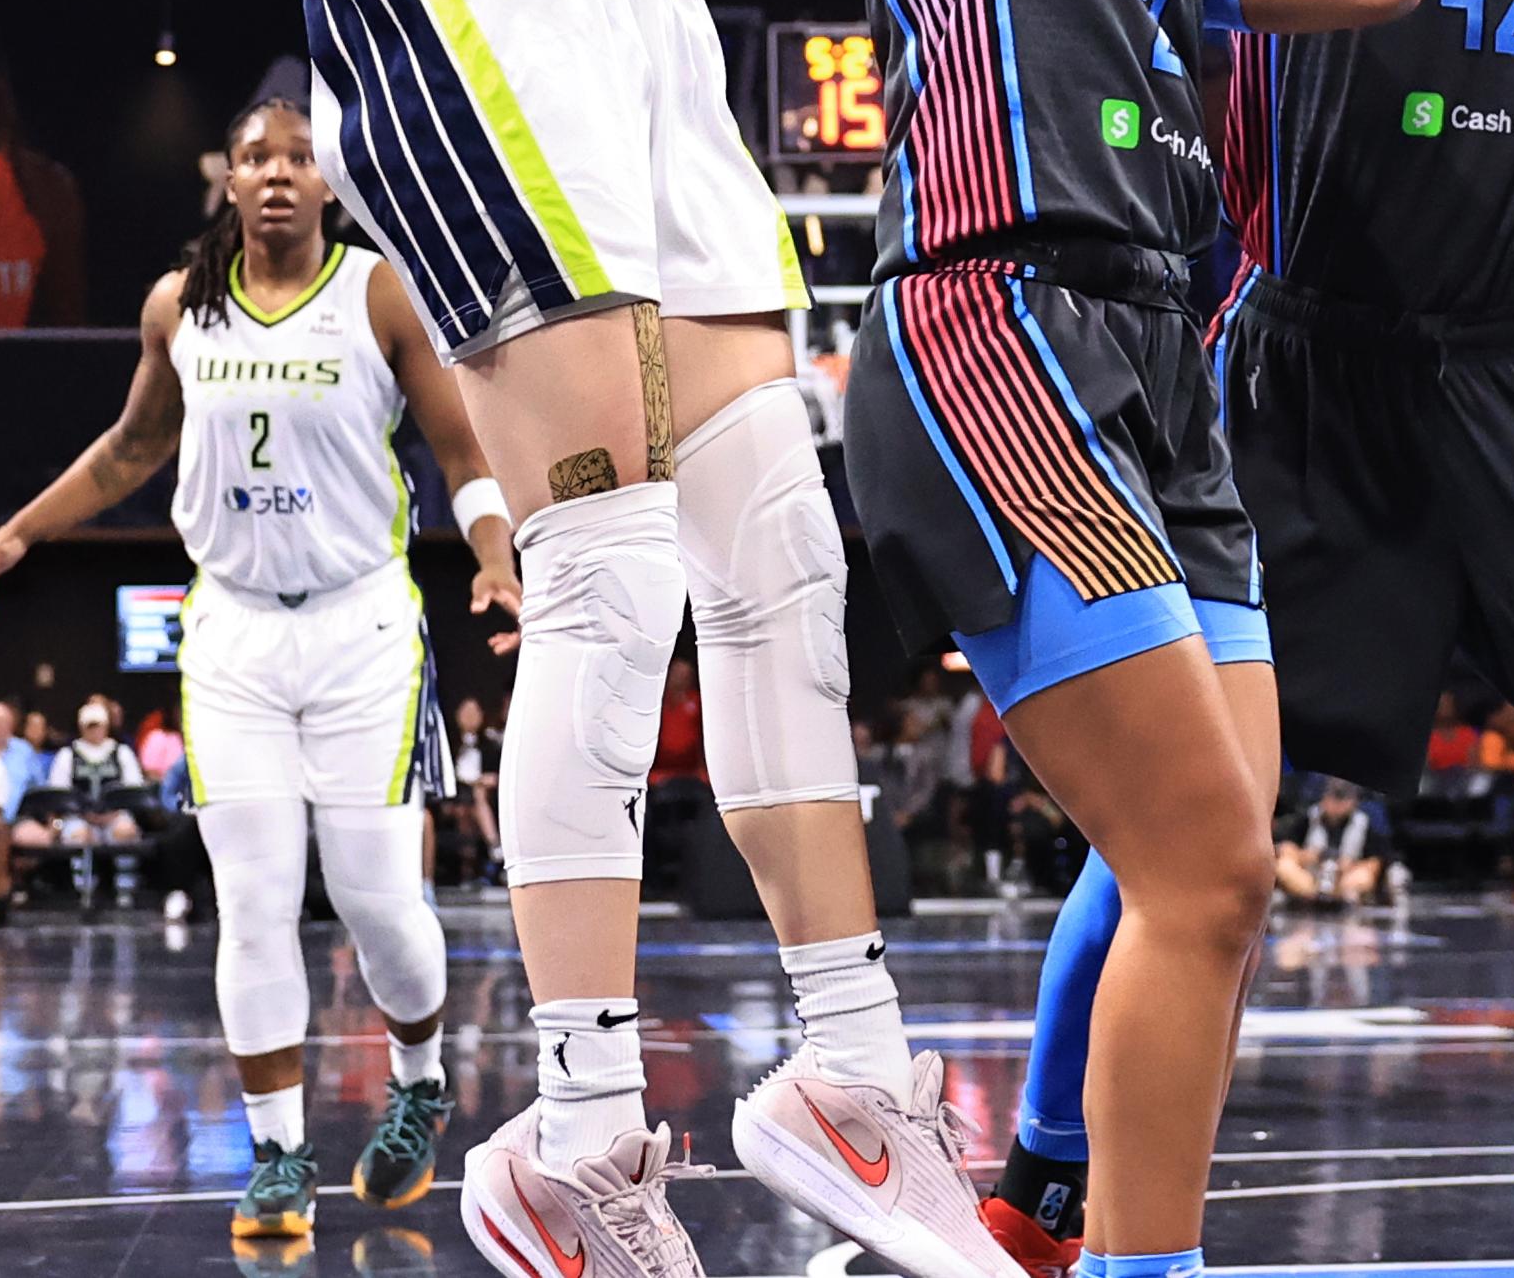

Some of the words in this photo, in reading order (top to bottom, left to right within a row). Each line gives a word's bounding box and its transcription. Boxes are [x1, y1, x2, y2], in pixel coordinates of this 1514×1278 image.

[819, 77, 885, 150] 15
[1451, 105, 1512, 134] Cash
[196, 356, 344, 387] WINGS
[250, 411, 271, 470] 2
